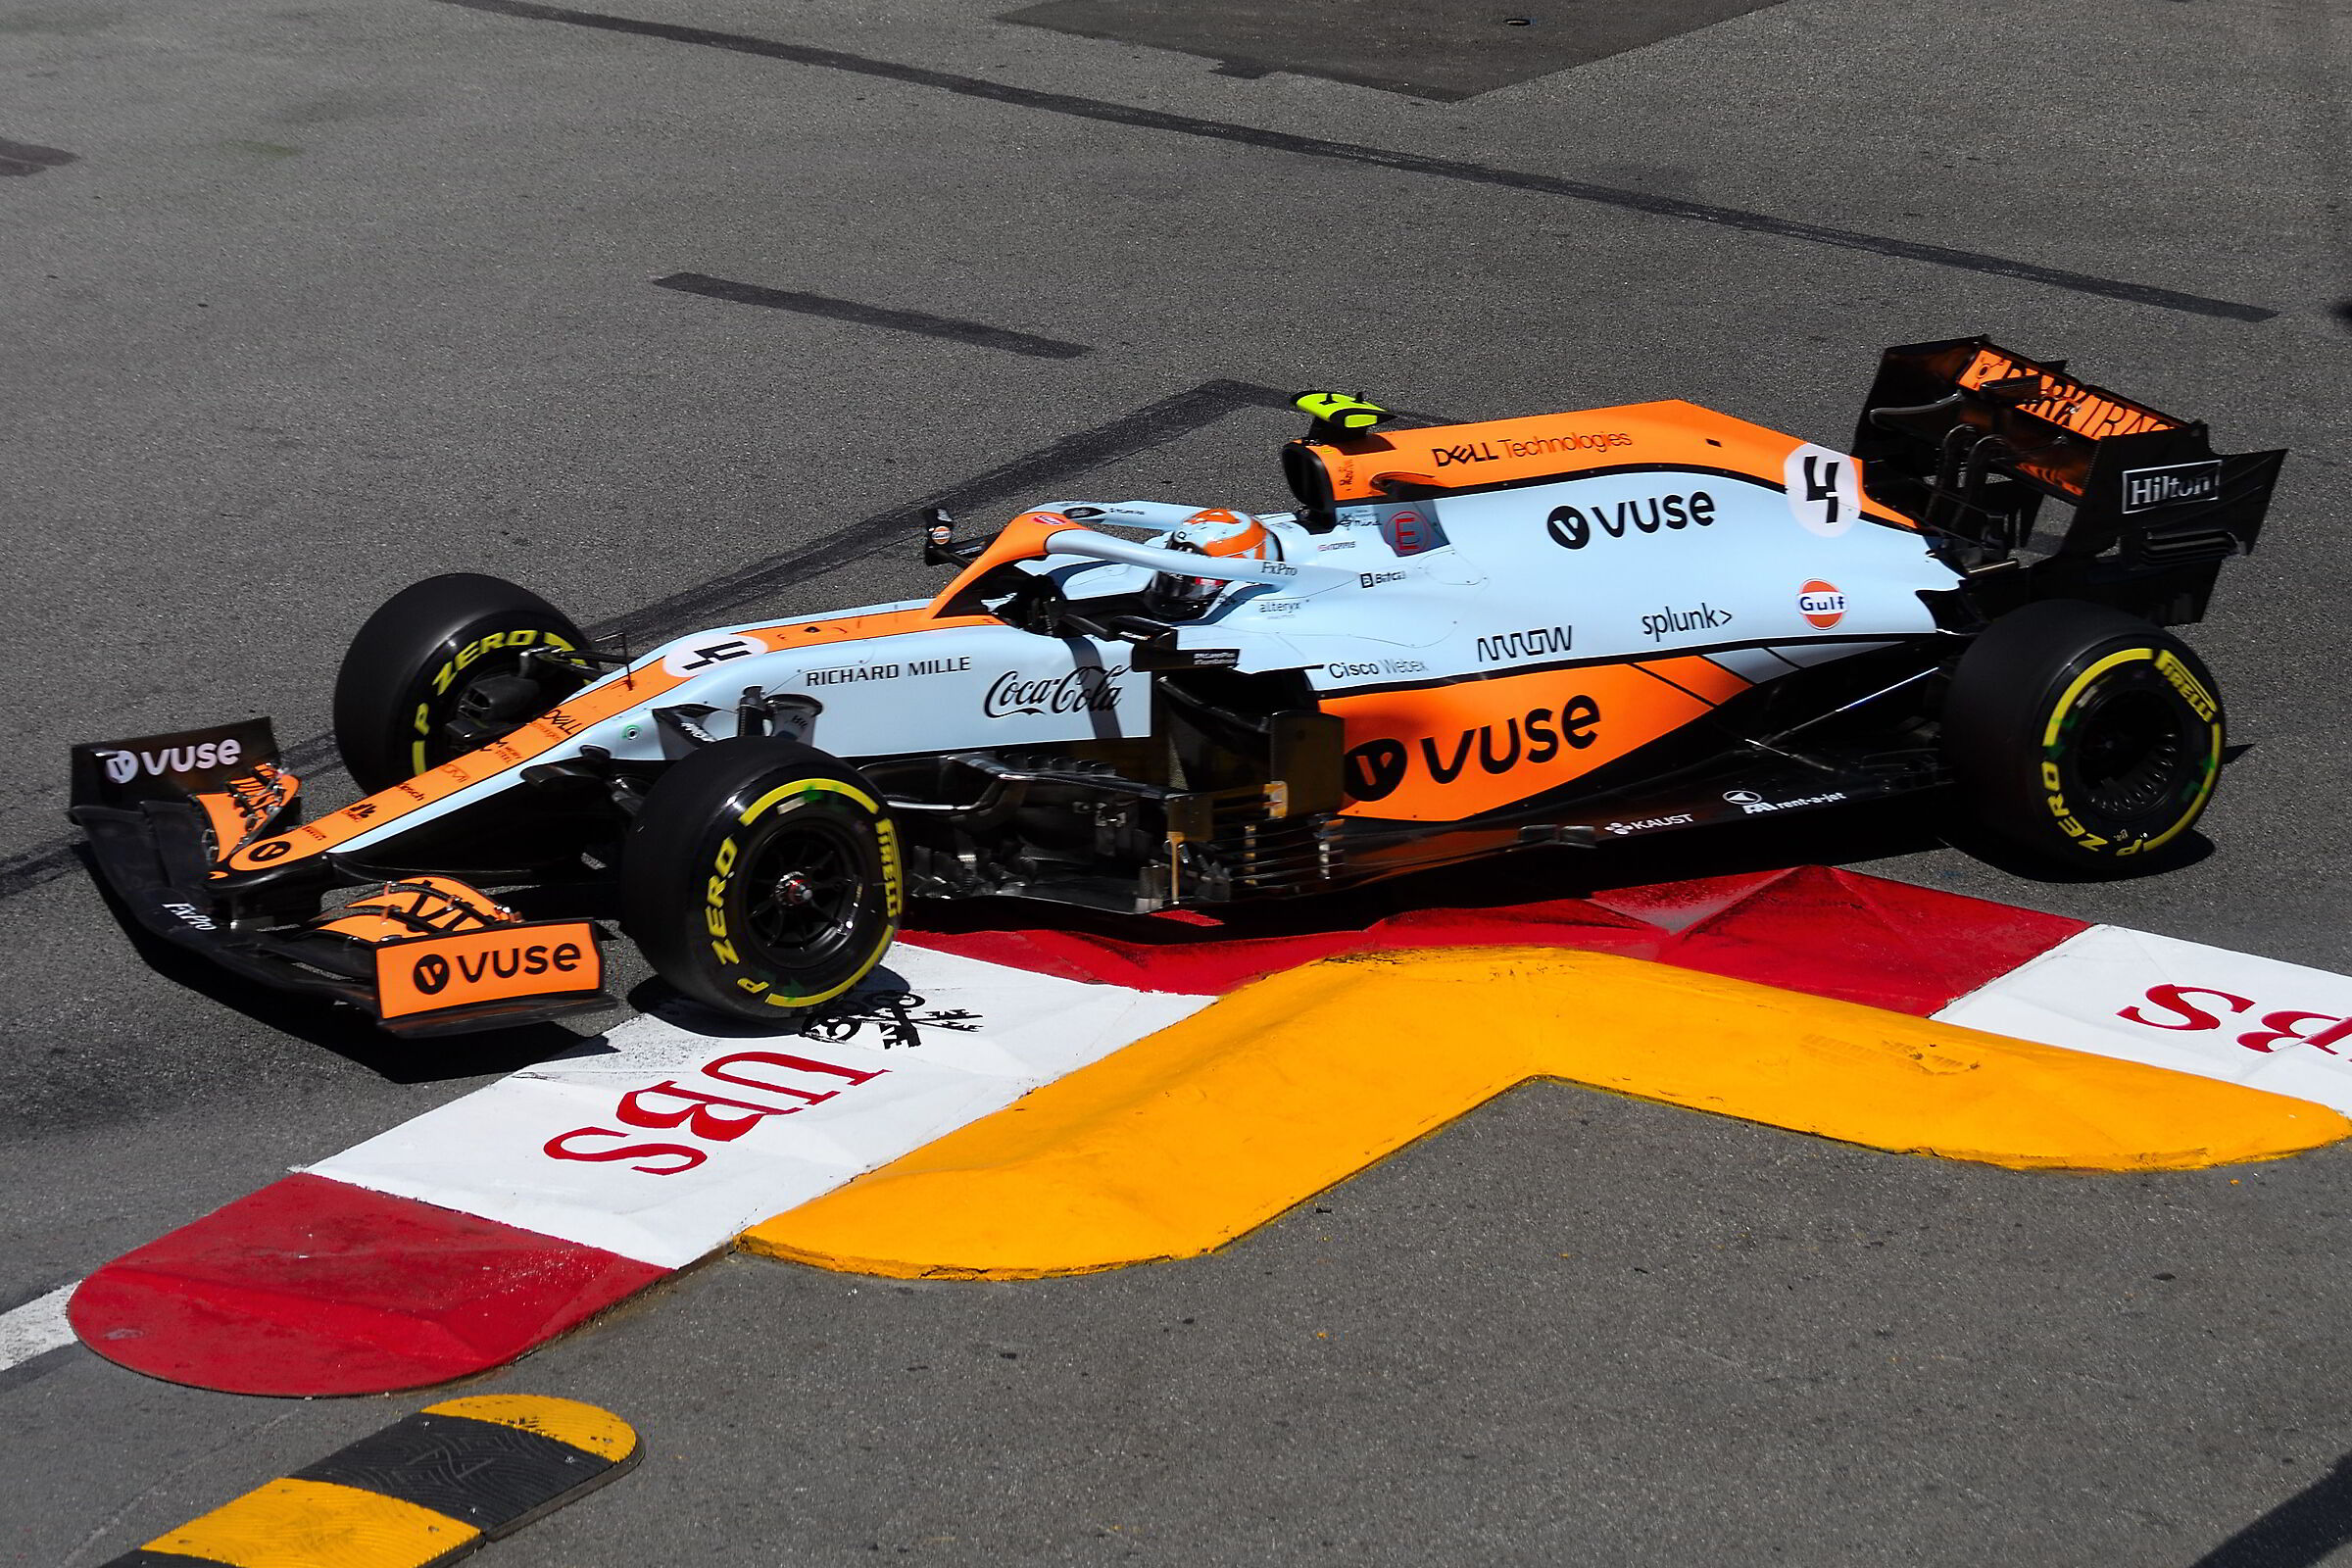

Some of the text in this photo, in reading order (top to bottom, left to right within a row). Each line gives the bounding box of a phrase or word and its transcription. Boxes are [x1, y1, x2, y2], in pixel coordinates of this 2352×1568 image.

[1432, 431, 1633, 466] DELL Technologies
[1803, 455, 1839, 523] 4
[2130, 474, 2212, 507] Hilton
[1396, 517, 1419, 550] E
[1258, 600, 1301, 613] alteryx
[1799, 594, 1846, 613] Gulf
[682, 640, 753, 670] 4
[807, 657, 972, 687] RICHARD MILLE
[1329, 659, 1429, 679] Cisco Webex
[414, 629, 539, 736] P ZERO
[983, 663, 1132, 718] Coca-Cola
[2154, 649, 2218, 723] PIRELLI
[1776, 792, 1846, 810] rent-a-jet
[2041, 760, 2109, 853] ZERO
[1631, 813, 1694, 830] KAUST
[875, 817, 904, 918] PIRELLI
[705, 835, 739, 965] ZERO
[2116, 983, 2352, 1062] BS
[543, 1051, 893, 1176] UBS
